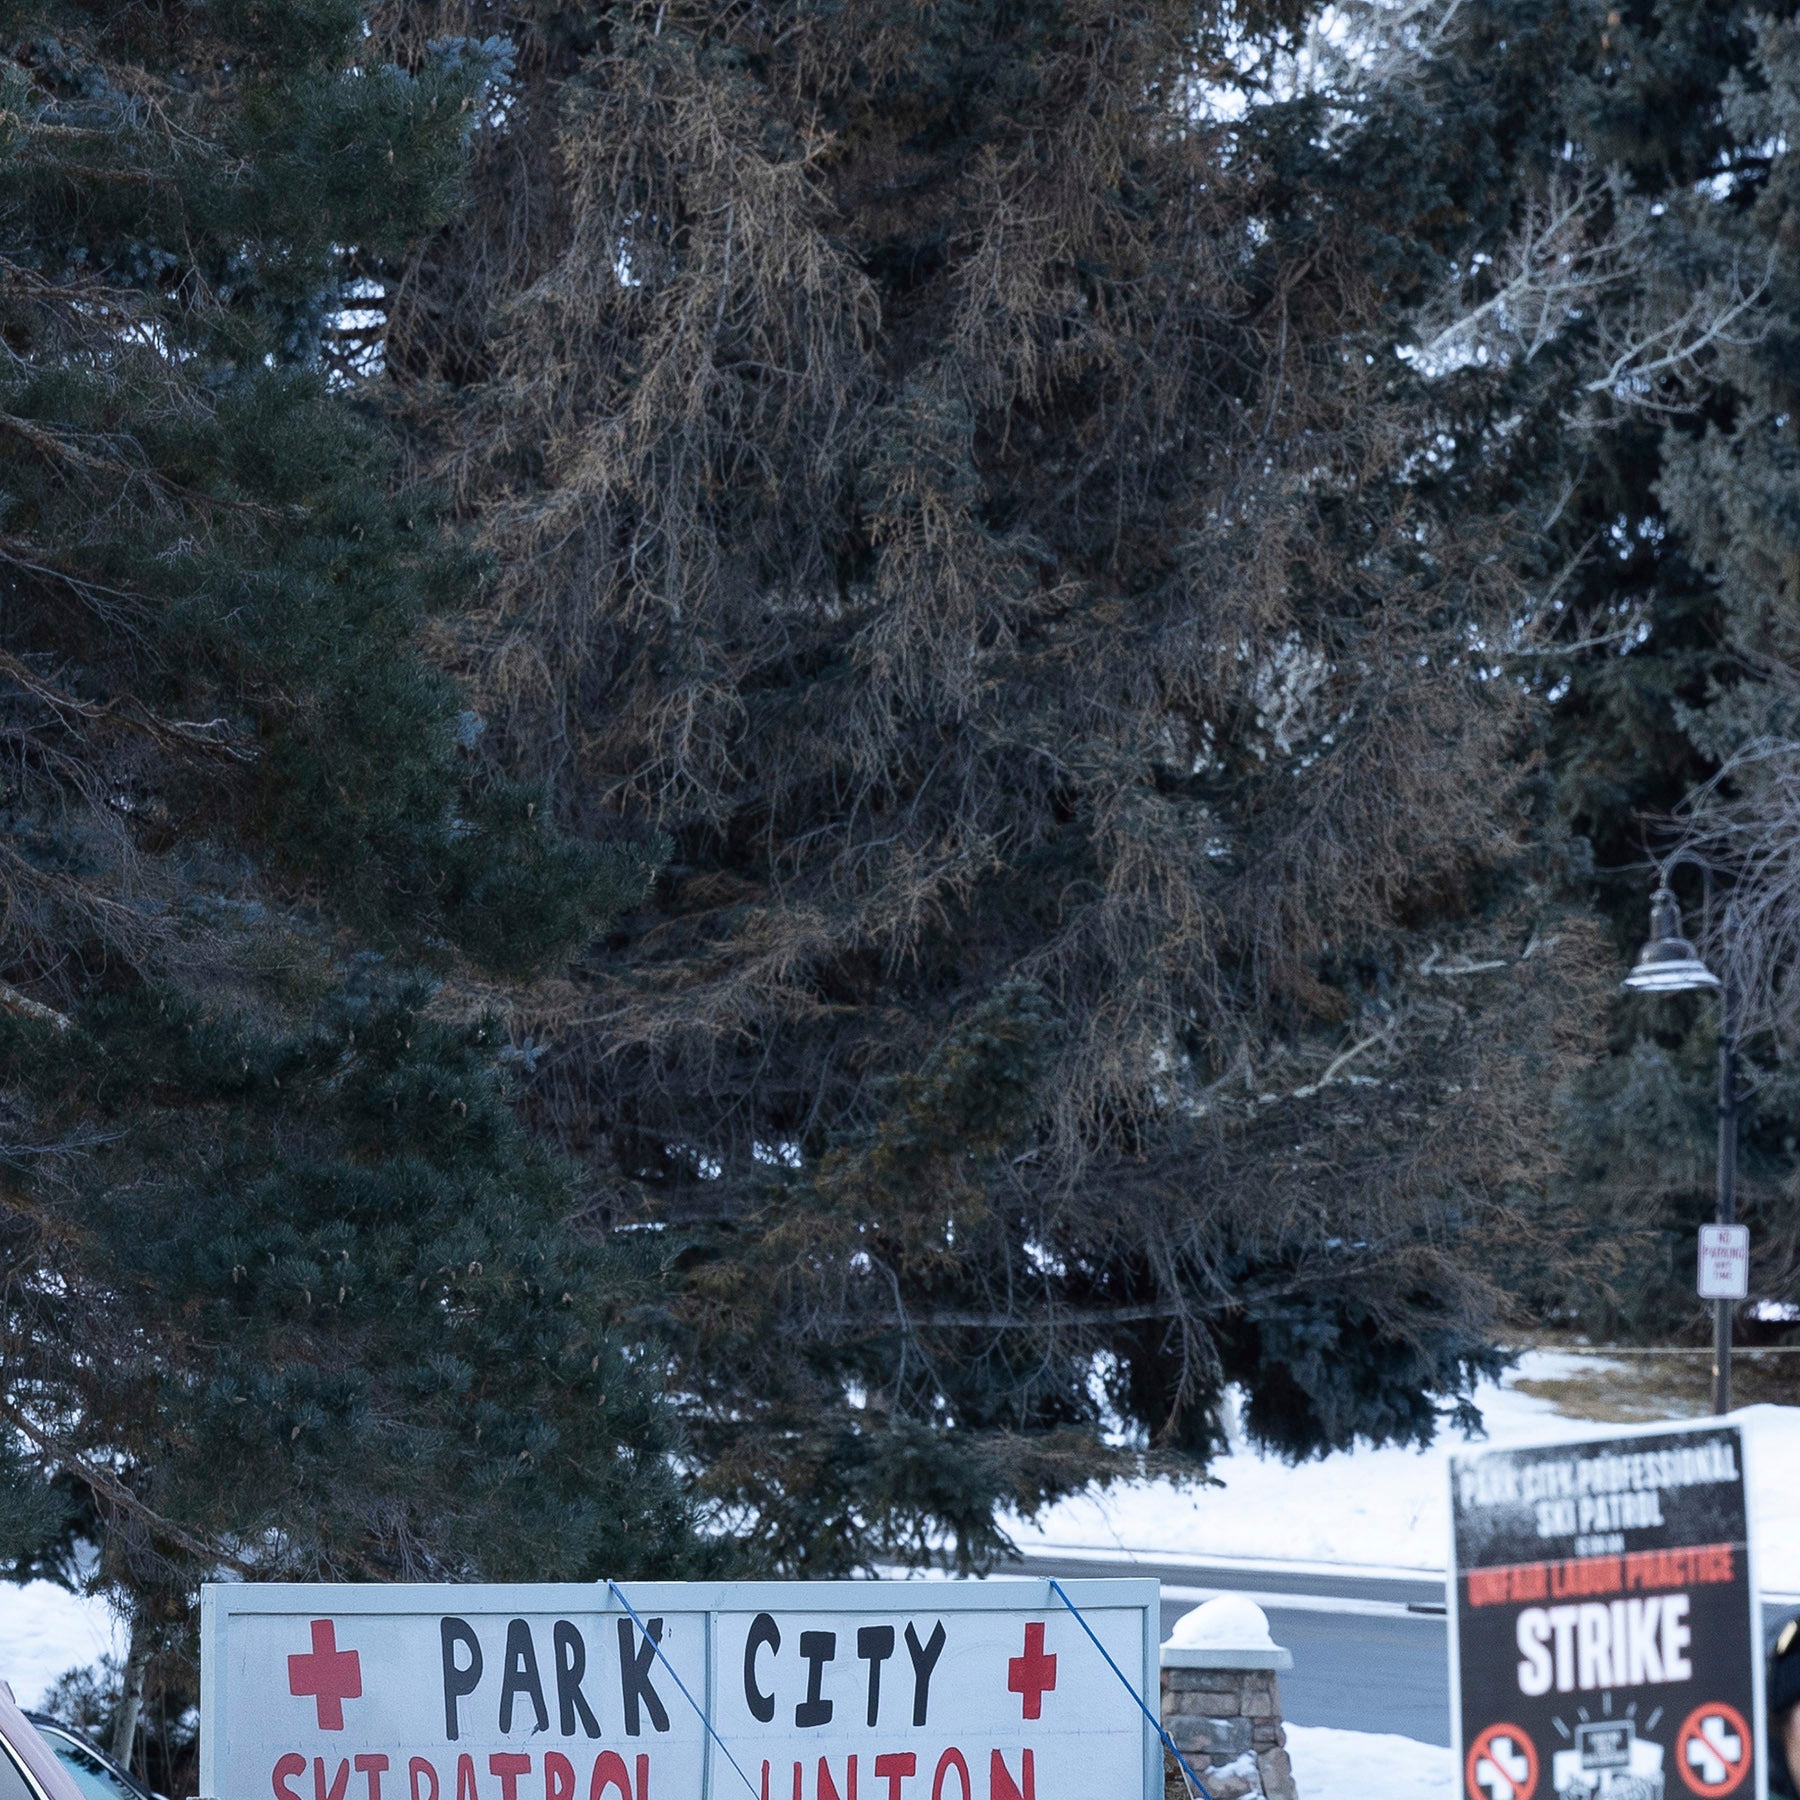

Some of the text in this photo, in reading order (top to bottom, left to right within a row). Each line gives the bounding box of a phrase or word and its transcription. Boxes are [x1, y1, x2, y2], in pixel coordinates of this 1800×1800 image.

[1577, 1443, 1739, 1497] PROFESSIONAL
[1536, 1490, 1665, 1538] SKI PATROL
[1467, 1561, 1549, 1607] UNFAIR
[1550, 1554, 1622, 1599] LABOR
[1625, 1542, 1735, 1591] PRACTICE
[440, 1612, 947, 1741] PARK CITY
[1516, 1594, 1693, 1697] STRIKE
